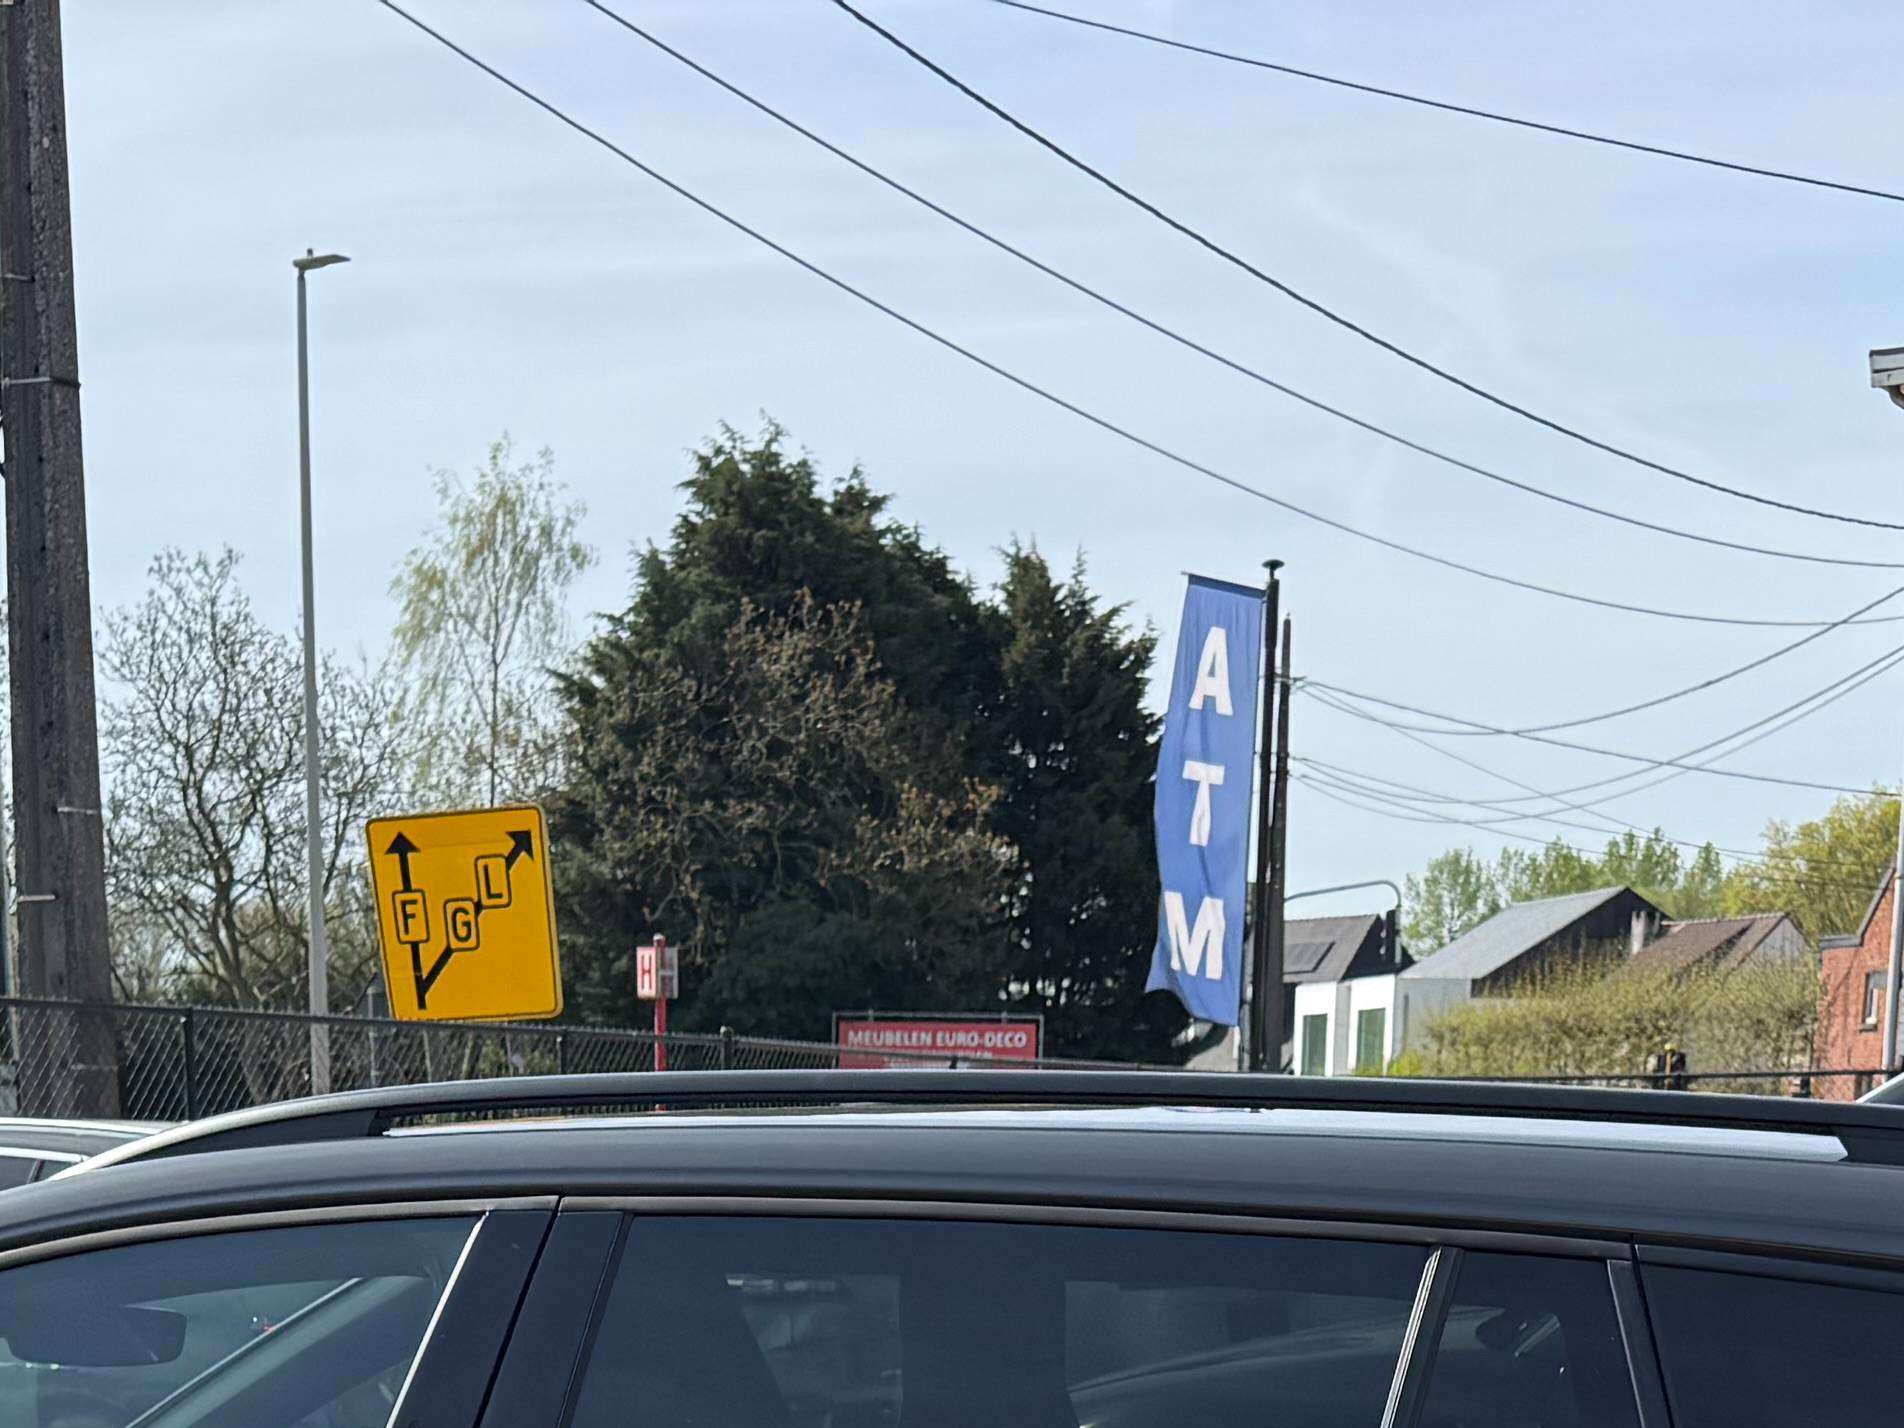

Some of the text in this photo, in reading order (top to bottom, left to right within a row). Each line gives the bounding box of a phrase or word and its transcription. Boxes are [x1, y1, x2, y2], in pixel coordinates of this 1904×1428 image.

[1164, 626, 1233, 979] ATM
[483, 864, 504, 900] L
[400, 899, 419, 936] F
[451, 906, 472, 943] G
[848, 1030, 1028, 1048] MEUBELEN EURO-DECO
